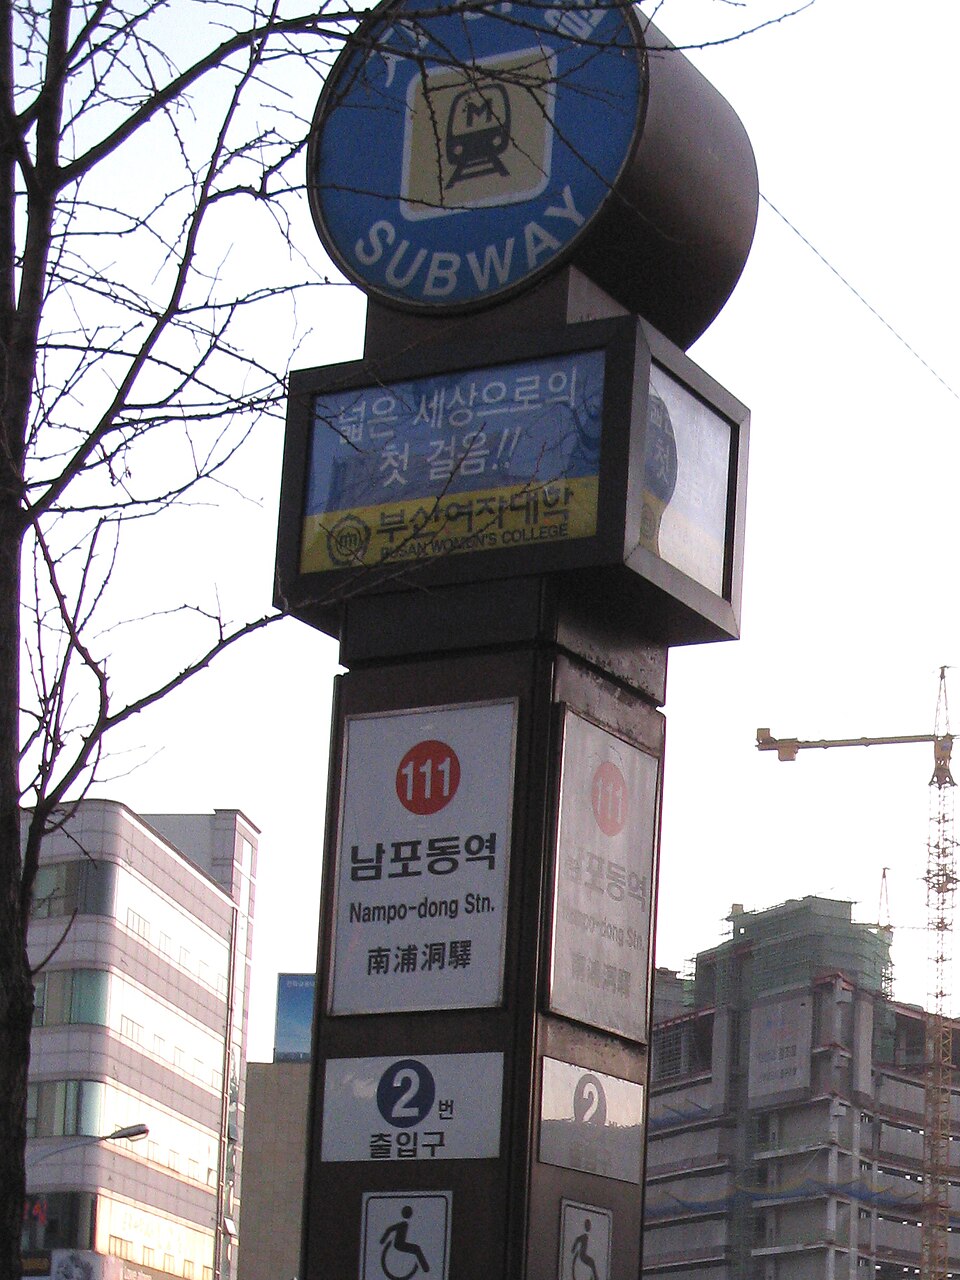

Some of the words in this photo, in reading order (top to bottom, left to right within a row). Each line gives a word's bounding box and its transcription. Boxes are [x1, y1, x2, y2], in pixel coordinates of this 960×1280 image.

[355, 185, 586, 297] SUBWAY
[413, 366, 578, 430] 세상으로의
[379, 440, 410, 488] 첫
[377, 485, 574, 543] 부산여자대학
[502, 521, 569, 544] COLLEGE
[401, 757, 450, 801] 111
[350, 832, 497, 882] 남포동역
[349, 897, 459, 924] Nampo-dong
[465, 893, 495, 917] Stn.
[367, 939, 472, 976] 南浦洞驛
[391, 1067, 420, 1119] 2
[438, 1098, 455, 1121] 번
[369, 1131, 447, 1159] 출입구
